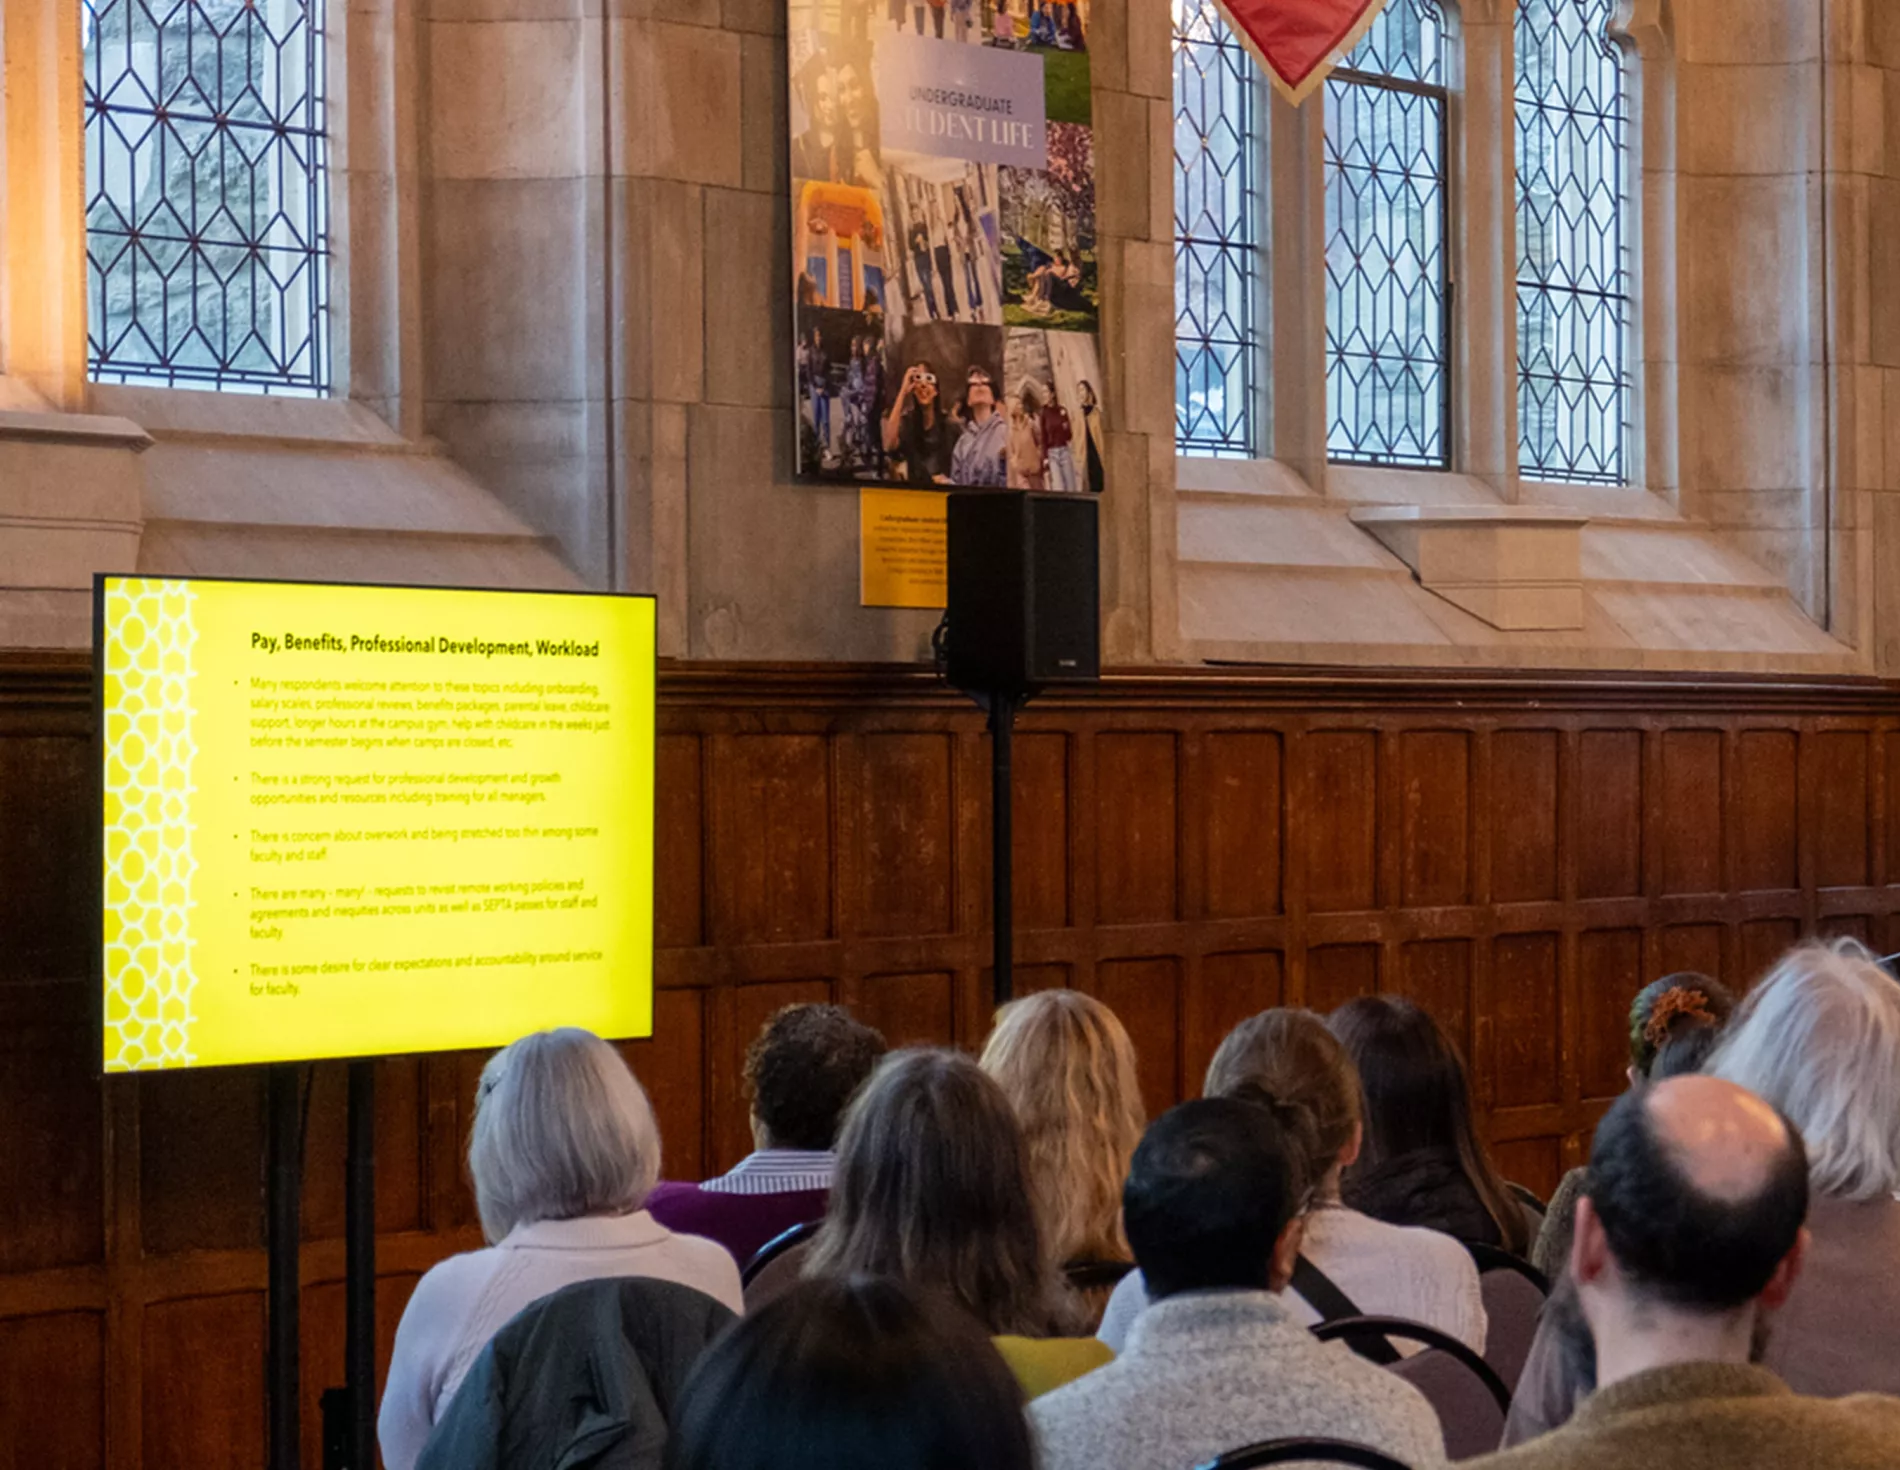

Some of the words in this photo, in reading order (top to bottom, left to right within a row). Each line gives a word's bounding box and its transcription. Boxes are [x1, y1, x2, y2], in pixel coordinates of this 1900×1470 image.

[909, 87, 1013, 115] UNDERGRADUATE
[992, 120, 1034, 149] LIFE
[252, 632, 281, 654] Pay,
[285, 633, 347, 653] Benefits,
[350, 634, 435, 653] Professional
[439, 637, 533, 659] Development,
[536, 640, 599, 657] Workload
[250, 677, 278, 692] Many
[280, 679, 342, 692] respondents
[343, 680, 387, 691] welcome
[433, 682, 443, 692] to
[445, 681, 470, 692] these
[472, 683, 500, 694] topics
[502, 682, 546, 697] including
[250, 698, 278, 710] salary
[316, 698, 374, 710] professional
[417, 698, 454, 710] benefits
[504, 701, 541, 712] parental
[570, 701, 609, 712] childcare
[295, 719, 325, 732] longer
[329, 718, 356, 728] hours
[359, 719, 367, 728] at
[370, 718, 385, 728] the
[388, 720, 424, 730] campus
[452, 720, 472, 731] help
[474, 719, 493, 728] with
[496, 719, 537, 730] childcare
[537, 721, 547, 729] in
[549, 720, 564, 730] the
[565, 719, 593, 730] weeks
[594, 721, 609, 733] just
[250, 734, 283, 747] before
[285, 736, 302, 747] the
[304, 737, 348, 747] semester
[351, 737, 383, 751] begins
[414, 738, 444, 749] camps
[446, 738, 462, 747] are
[251, 771, 279, 785] There
[281, 776, 289, 785] is
[292, 776, 298, 784] a
[300, 775, 331, 788] strong
[334, 774, 370, 786] request
[372, 772, 386, 784] for
[388, 772, 445, 786] professional
[447, 773, 508, 785] development
[510, 772, 528, 784] and
[530, 772, 561, 786] growth
[250, 793, 317, 806] opportunities
[319, 792, 338, 804] and
[340, 794, 387, 803] resources
[389, 791, 434, 806] including
[434, 792, 472, 805] training
[471, 790, 485, 802] for
[487, 790, 498, 802] all
[250, 829, 279, 843] There
[281, 833, 290, 842] is
[291, 832, 331, 842] concern
[333, 829, 362, 841] about
[364, 829, 408, 840] overwork
[410, 828, 429, 840] and
[430, 828, 459, 842] being
[460, 827, 503, 839] stretched
[504, 828, 521, 838] too
[522, 826, 540, 837] thin
[542, 828, 574, 840] among
[573, 827, 598, 837] some
[250, 849, 282, 864] faculty
[285, 849, 304, 861] and
[250, 887, 279, 900] There
[281, 890, 298, 900] are
[299, 889, 326, 900] many
[374, 885, 415, 898] requests
[416, 885, 427, 895] to
[457, 884, 491, 894] remote
[493, 882, 530, 895] working
[530, 879, 567, 894] policies
[566, 879, 584, 891] and
[250, 908, 311, 923] agreements
[310, 905, 331, 917] and
[381, 905, 412, 915] across
[413, 903, 436, 914] units
[438, 904, 449, 913] as
[450, 900, 469, 912] well
[471, 903, 481, 912] as
[483, 898, 513, 912] SEPTA
[514, 901, 545, 912] passes
[544, 897, 559, 909] for
[560, 895, 579, 909] staff
[581, 896, 597, 908] and
[250, 963, 279, 976] There
[280, 966, 290, 975] is
[291, 965, 320, 975] some
[319, 961, 350, 974] desire
[352, 958, 366, 972] for
[368, 959, 391, 971] clear
[393, 958, 453, 971] expectations
[454, 955, 473, 967] and
[474, 952, 538, 966] accountability
[537, 950, 572, 963] around
[571, 951, 602, 962] service
[250, 982, 264, 996] for
